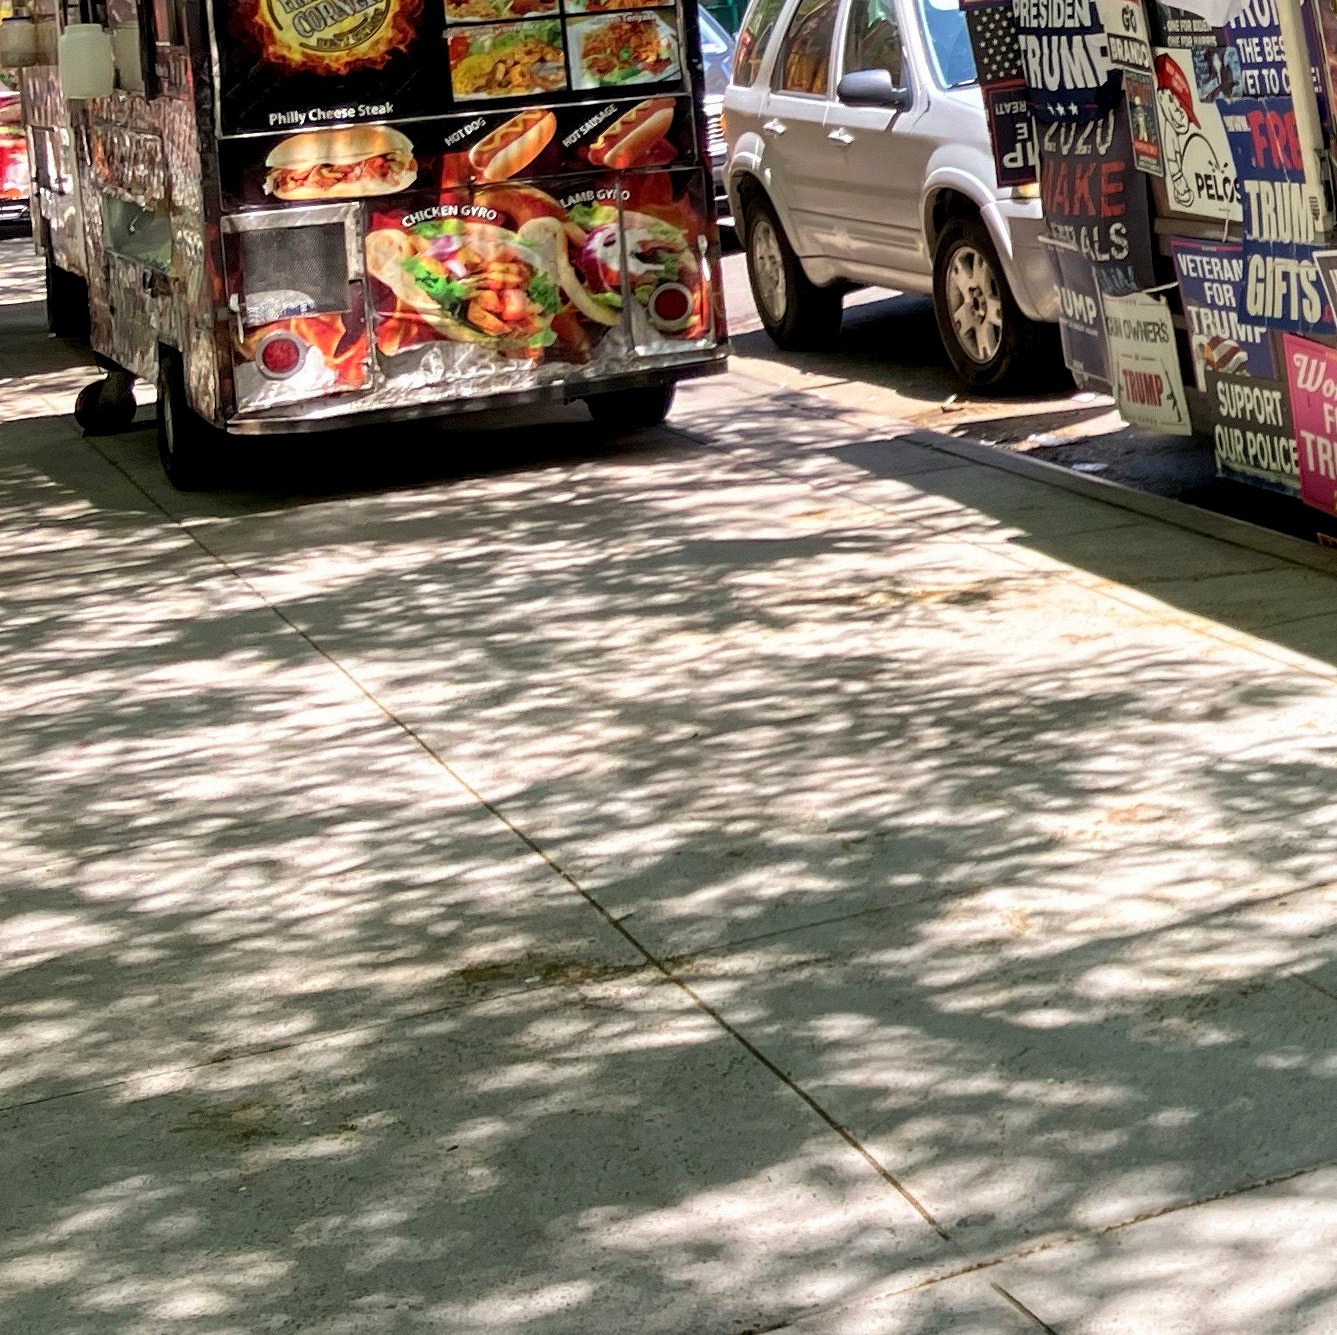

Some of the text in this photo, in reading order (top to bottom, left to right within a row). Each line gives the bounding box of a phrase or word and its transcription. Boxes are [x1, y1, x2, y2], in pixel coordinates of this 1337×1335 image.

[1236, 37, 1262, 64] THE
[269, 102, 394, 126] Philly Cheese Steak
[562, 103, 619, 148] HOT SAUSAGE
[444, 117, 487, 147] HOT DOG
[559, 190, 593, 209] LAMB
[401, 203, 498, 227] CHICKEN GYRO
[1205, 282, 1236, 308] FOR
[1246, 254, 1322, 324] GIFTS
[1122, 369, 1164, 407] TRUMP
[1217, 381, 1283, 427] SUPPORT
[1214, 425, 1299, 475] OUR POLICE
